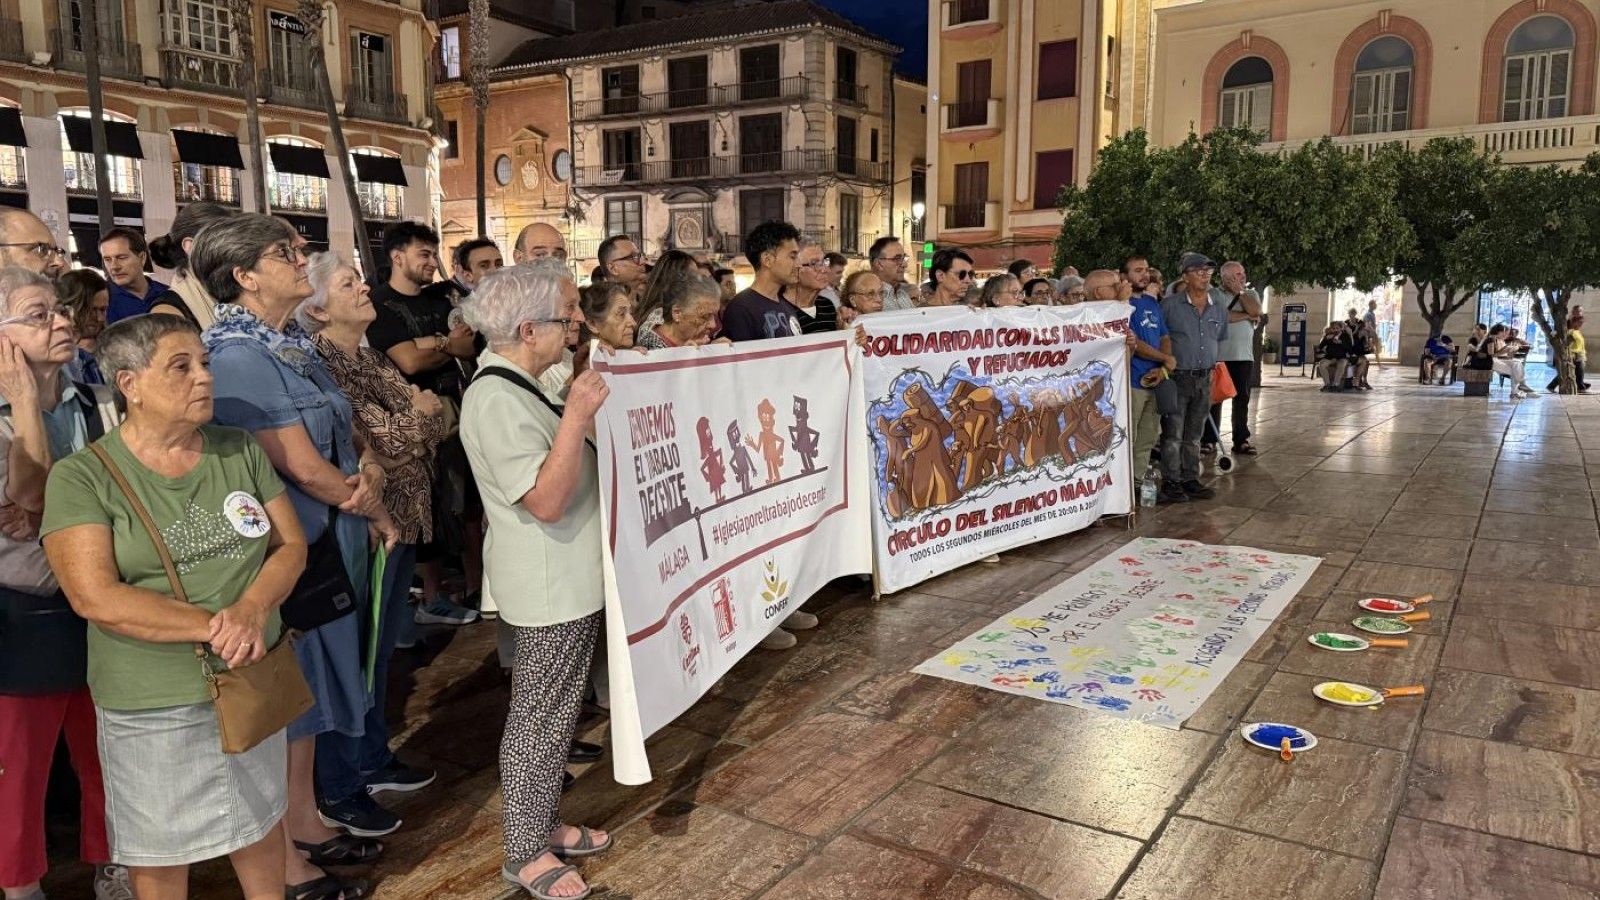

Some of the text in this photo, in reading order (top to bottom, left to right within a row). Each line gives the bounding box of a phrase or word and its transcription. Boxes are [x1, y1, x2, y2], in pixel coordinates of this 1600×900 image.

[862, 328, 994, 357] SOLIDARIDAD
[997, 327, 1031, 347] CON
[967, 349, 1072, 376] Y REFUGIADOS
[633, 454, 646, 485] EL
[638, 471, 687, 526] DECENTE
[888, 471, 1112, 556] CÍRCULO DEL SILENCIO MÁLA
[909, 547, 931, 563] TODOS
[932, 543, 945, 555] LOS
[945, 530, 983, 550] SEGUNDOS
[1020, 516, 1033, 528] DEL
[1033, 512, 1047, 525] MES
[1047, 510, 1057, 520] DE
[1079, 503, 1085, 513] A
[658, 544, 690, 584] MÁLAGA
[1075, 621, 1102, 630] EL
